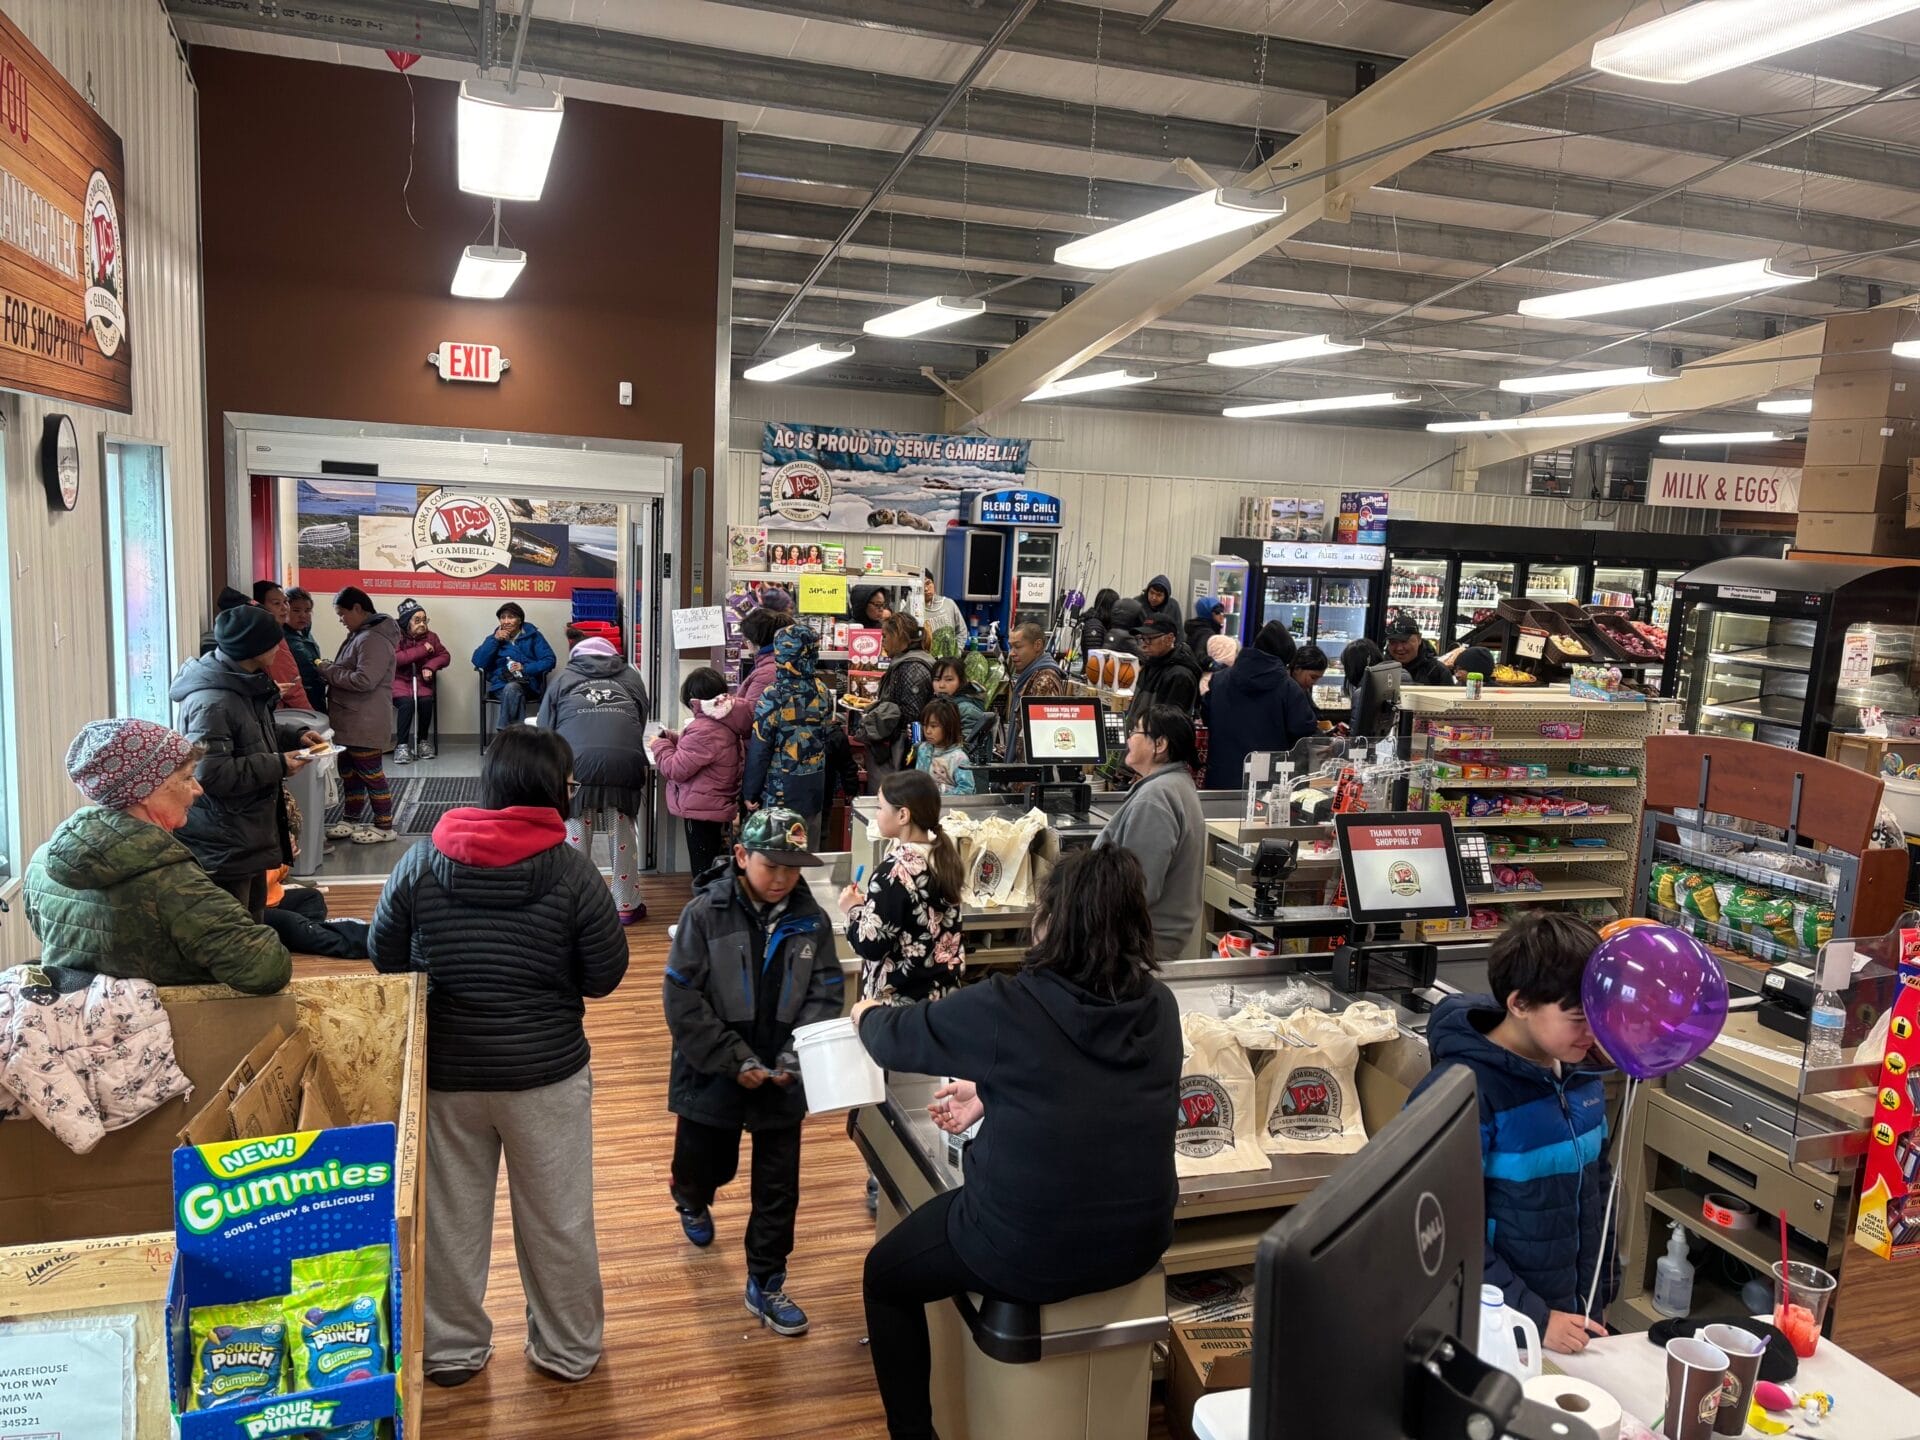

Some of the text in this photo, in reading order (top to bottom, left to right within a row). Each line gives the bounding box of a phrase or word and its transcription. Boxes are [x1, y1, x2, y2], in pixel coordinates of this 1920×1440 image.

[4, 294, 84, 366] FOR SHOPPING
[450, 344, 492, 378] EXIT
[773, 429, 1020, 463] AC IS PROUD TO SERVE GAMBELL!!
[1662, 472, 1779, 503] MILK & EGGS
[982, 501, 1056, 514] BLEND SIP CHILL
[418, 506, 432, 543] ALASKA
[489, 502, 507, 546] COMPANY
[986, 513, 1010, 521] SHAKES
[1019, 514, 1054, 522] SMOOTHIES
[436, 546, 489, 556] GAMBELL
[1264, 547, 1285, 559] Fresh
[437, 560, 488, 574] SINCE 1867
[500, 579, 530, 592] SINCE
[532, 581, 557, 593] 1867
[1369, 828, 1422, 837] THANK YOU FOR
[1375, 837, 1419, 846] SHOPPING AT
[1326, 1079, 1337, 1114] COMPANY
[1213, 1089, 1230, 1127] COMPANY
[222, 1139, 295, 1171] NEW!
[184, 1163, 388, 1230] Gummies
[223, 1193, 375, 1239] SOUR, CHEWY & DELICIOUS!
[1867, 1213, 1884, 1223] GREAT
[1862, 1223, 1887, 1238] LIGHTING
[1864, 1217, 1885, 1231] FOR ALL
[1857, 1225, 1891, 1244] OCCASIONS!
[325, 1320, 355, 1334] SOUR
[313, 1329, 370, 1351] PUNCH
[1201, 1341, 1248, 1350] KETCHUP
[225, 1342, 262, 1354] SOUR
[211, 1352, 275, 1371] PUNCH
[0, 1378, 57, 1390] YLOR WAY
[0, 1391, 43, 1403] MA WA
[264, 1402, 312, 1420] SOUR
[247, 1409, 334, 1438] PUNCH
